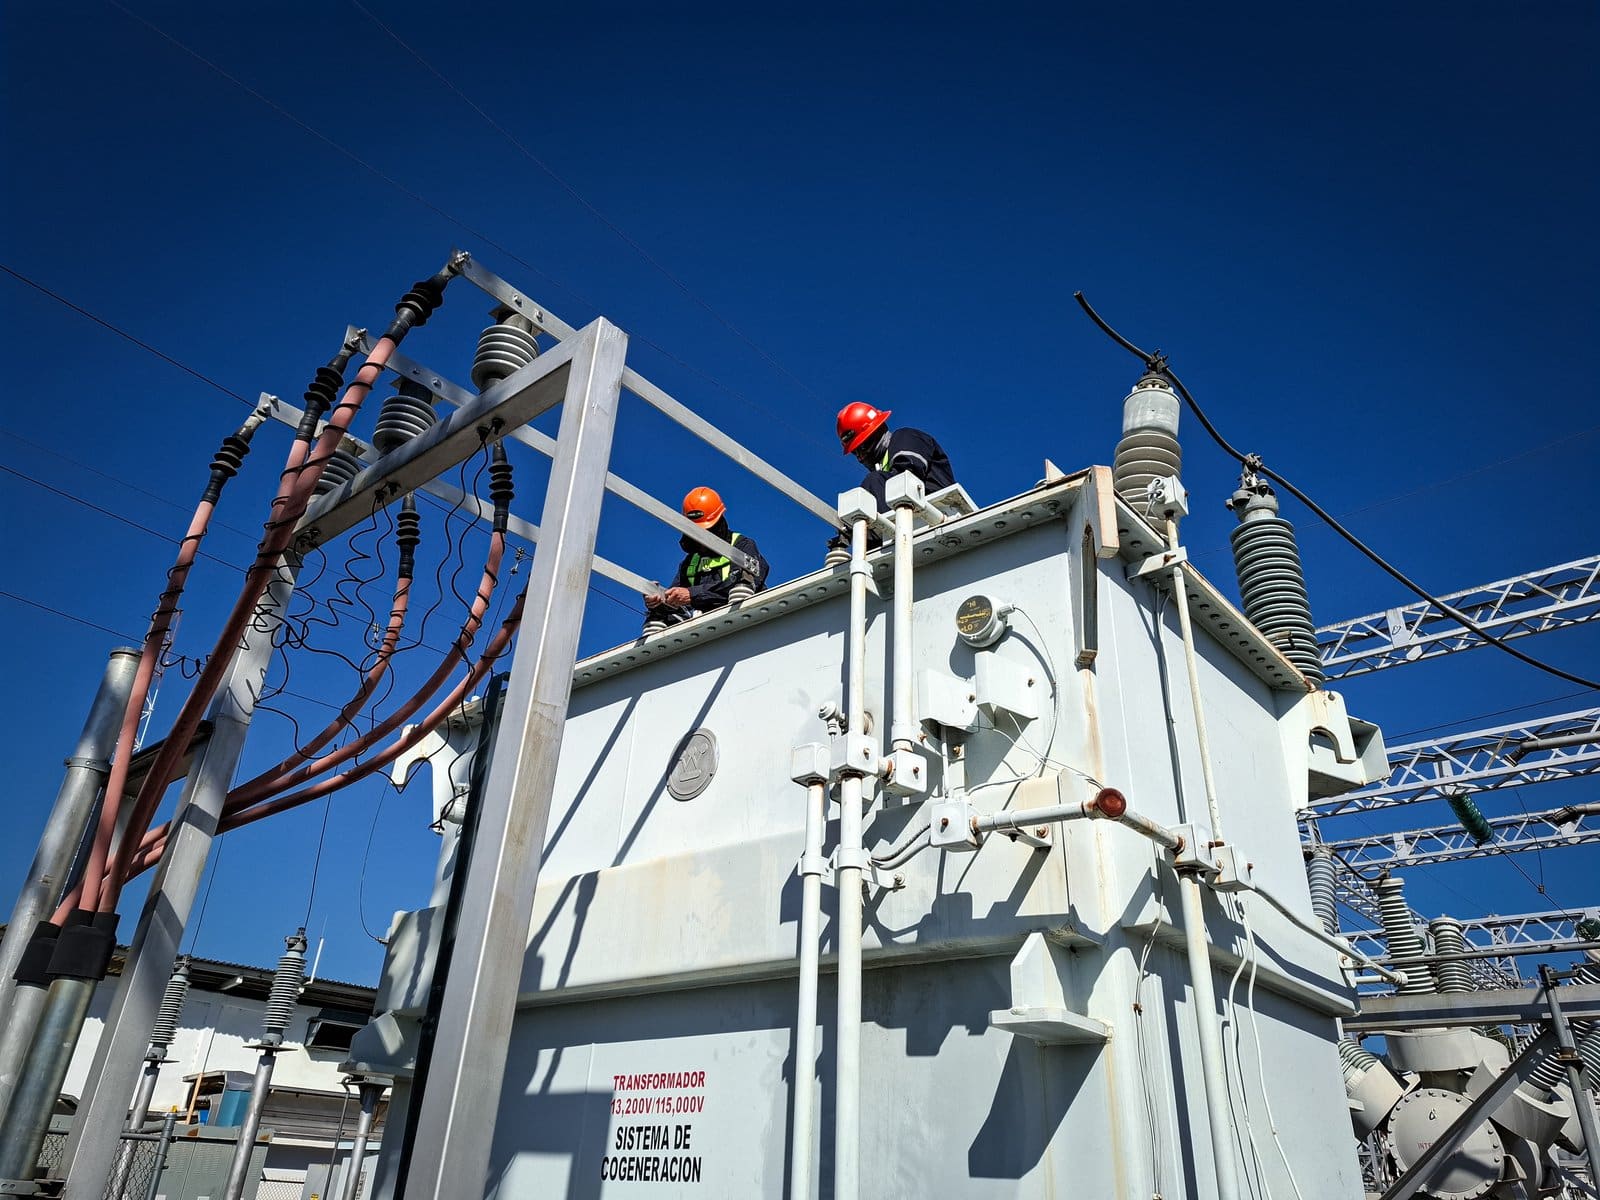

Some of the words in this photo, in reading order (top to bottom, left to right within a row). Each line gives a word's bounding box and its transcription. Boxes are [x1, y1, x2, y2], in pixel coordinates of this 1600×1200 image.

[613, 1071, 706, 1091] TRANSFORMADOR
[610, 1096, 705, 1117] 13,200V/115,000V
[615, 1125, 669, 1150] SISTEMA
[673, 1124, 692, 1150] DE
[600, 1156, 702, 1183] COGENERACION
